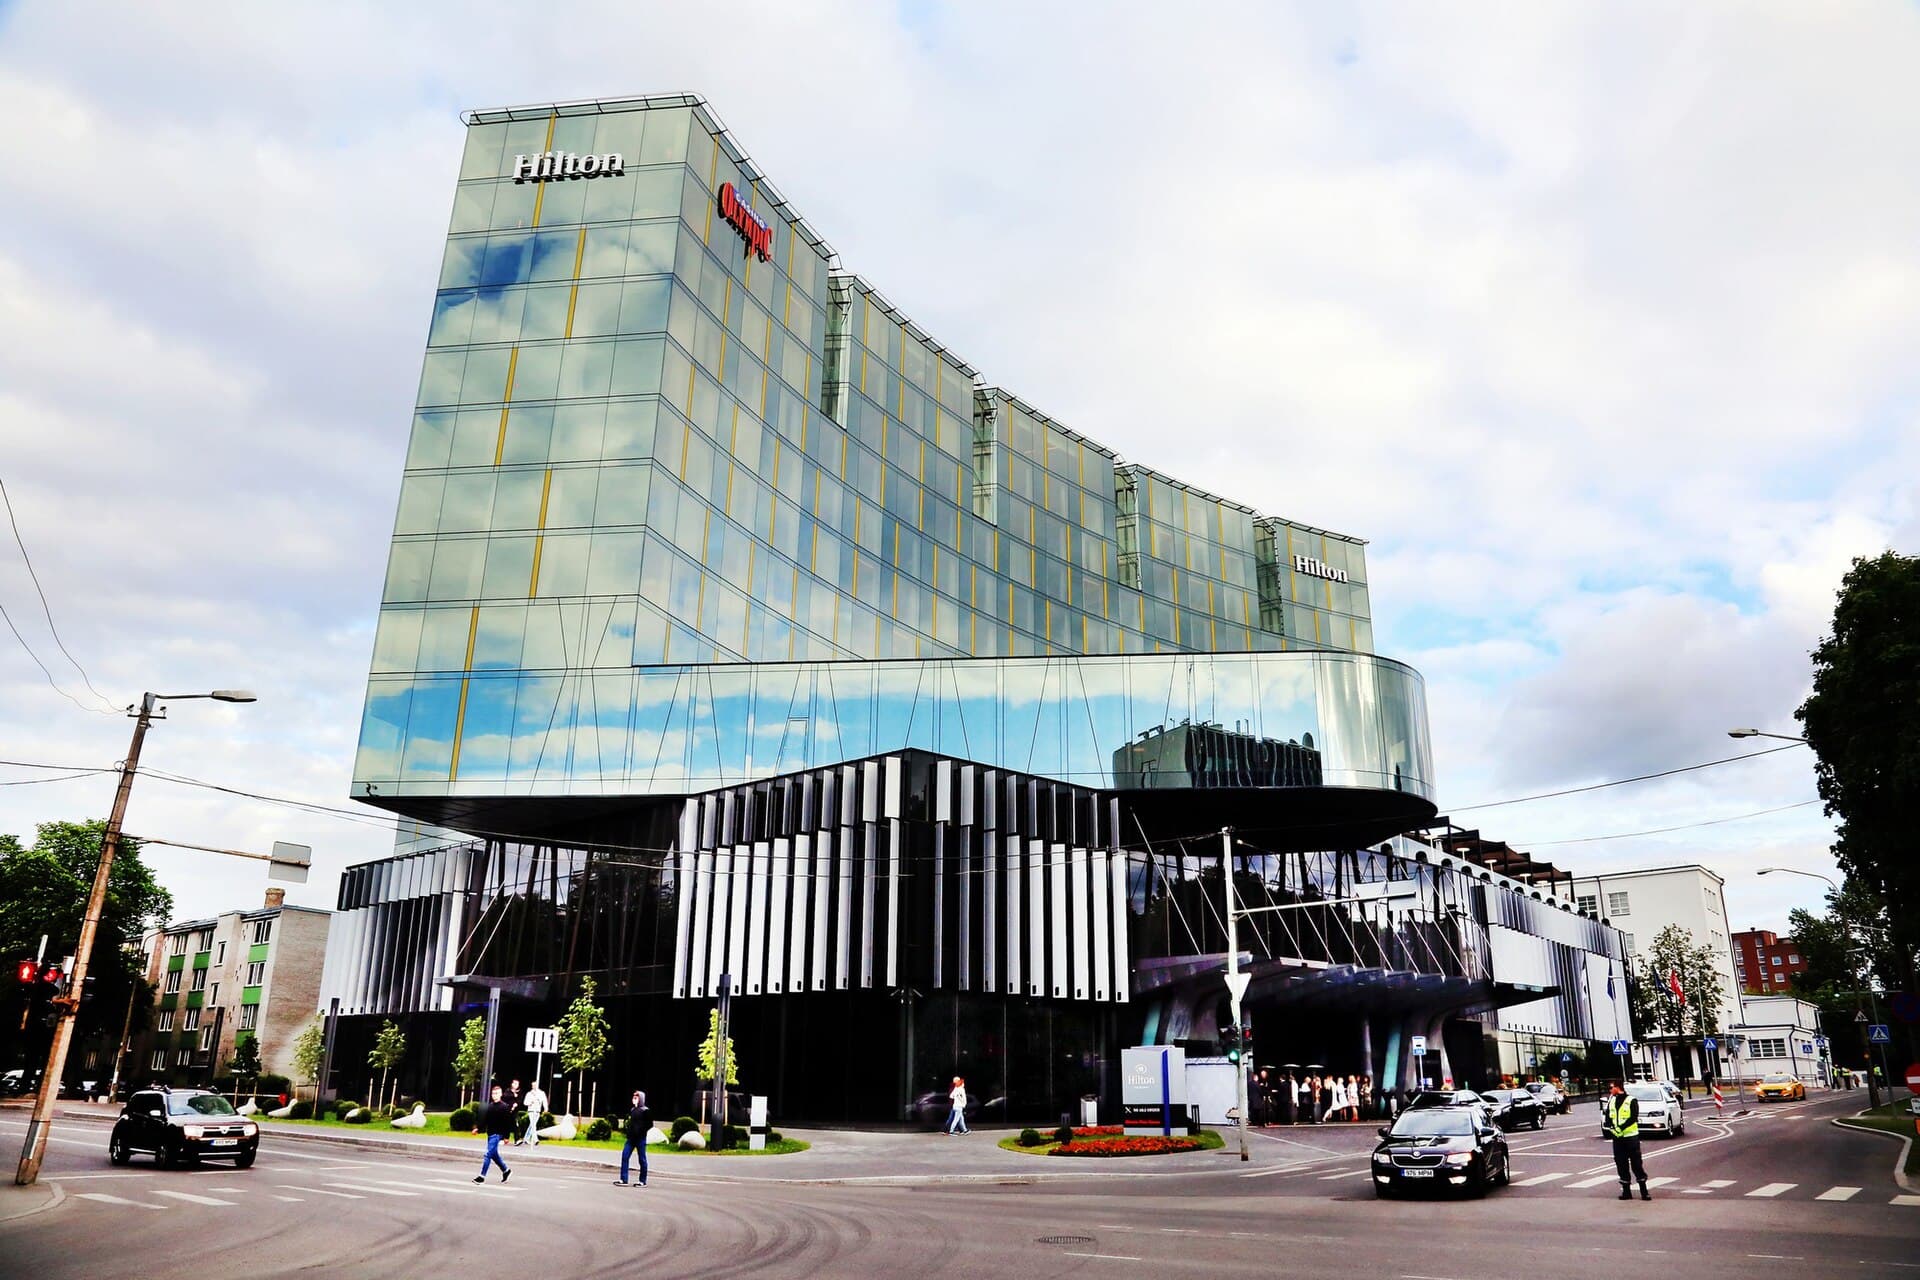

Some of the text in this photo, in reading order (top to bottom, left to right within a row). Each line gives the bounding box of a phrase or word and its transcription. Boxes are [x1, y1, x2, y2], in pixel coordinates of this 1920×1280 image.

[512, 151, 624, 182] Hilton
[735, 193, 766, 229] CASINO
[1294, 554, 1349, 584] Hilton
[1128, 1074, 1155, 1085] Hilton
